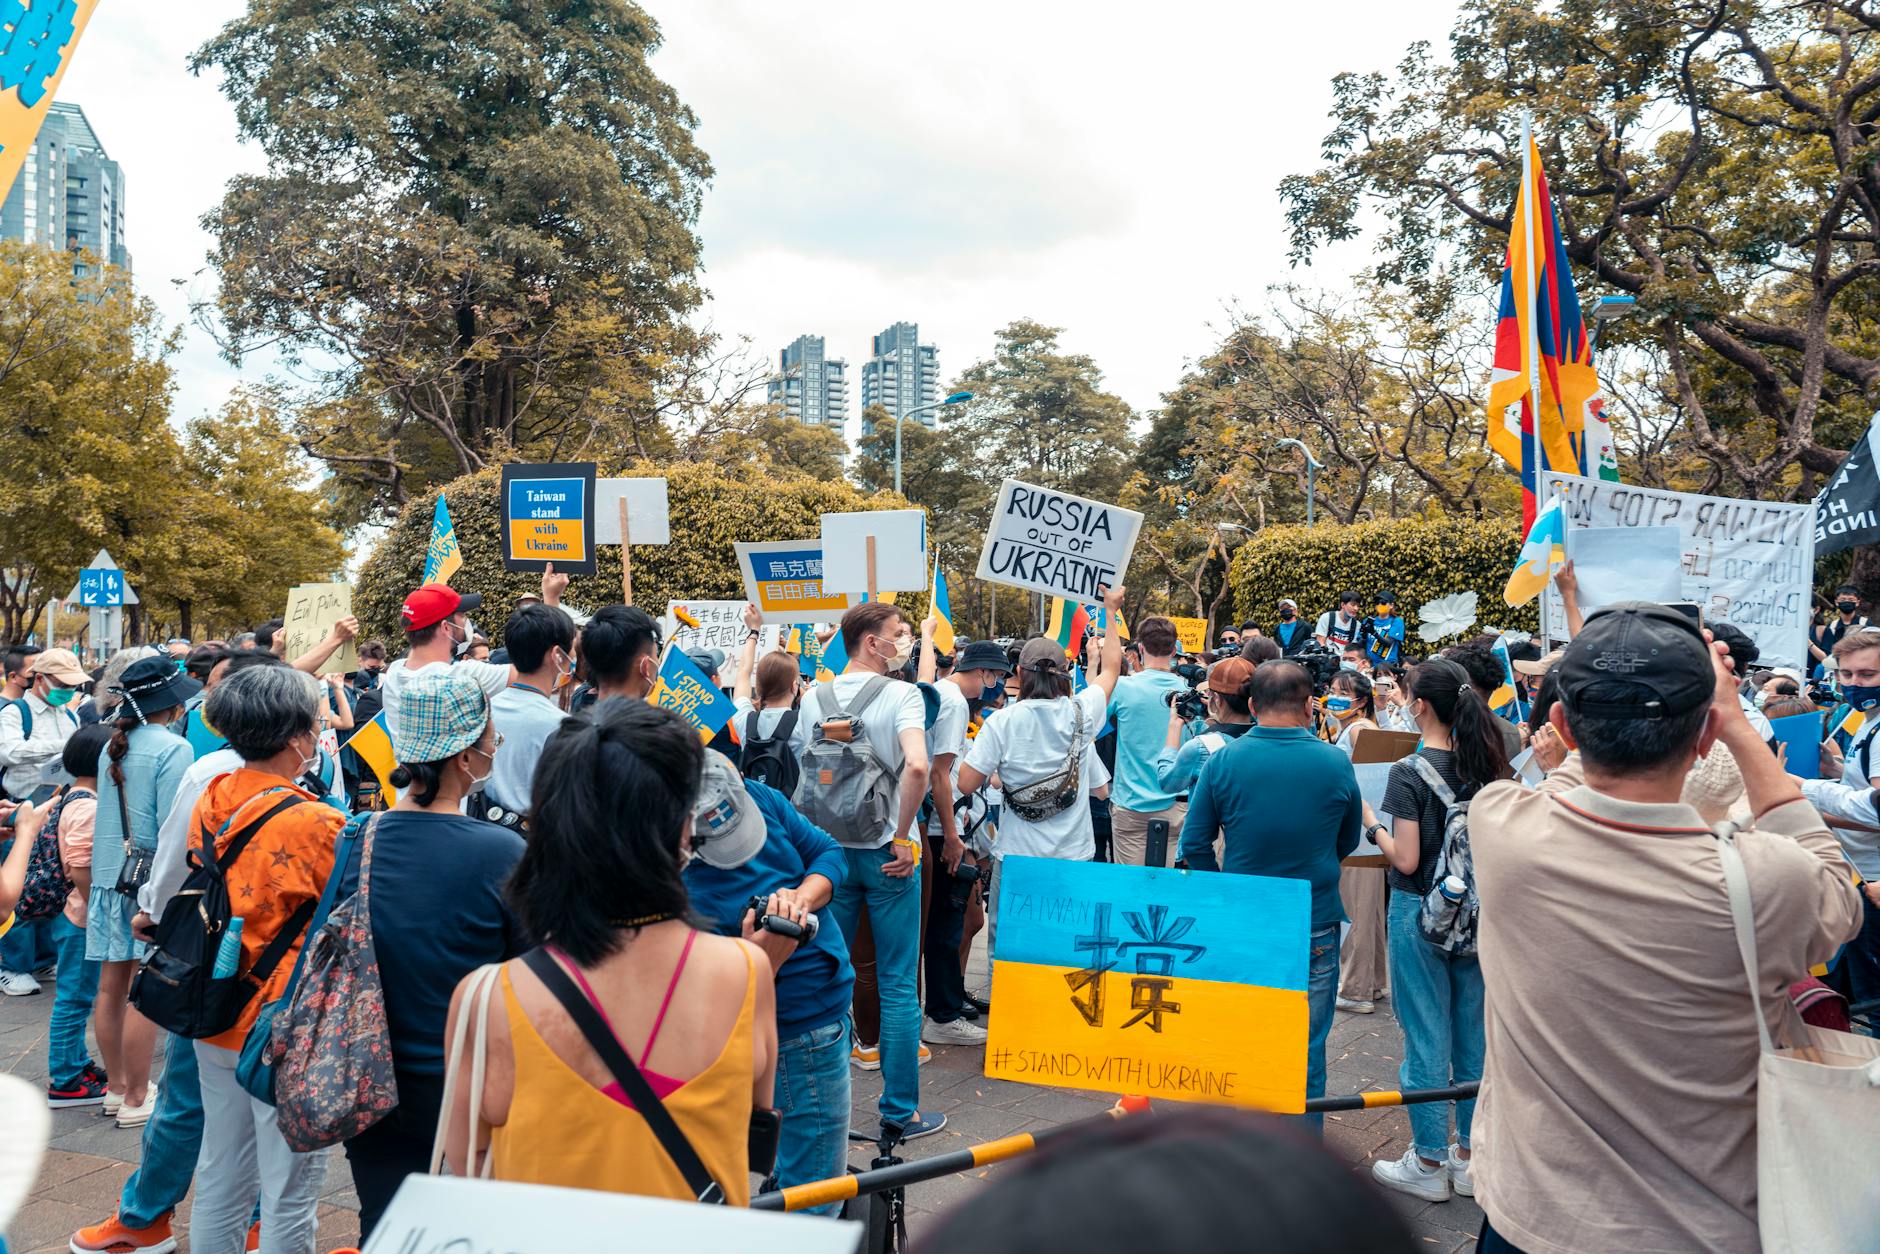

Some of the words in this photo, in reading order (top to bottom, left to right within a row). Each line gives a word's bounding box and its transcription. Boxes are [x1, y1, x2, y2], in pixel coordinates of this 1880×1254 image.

[526, 489, 566, 502] Taiwan
[531, 506, 560, 518] stand
[1007, 487, 1112, 540] RUSSIA
[534, 523, 558, 534] with
[1027, 528, 1063, 545] OUT
[1068, 537, 1093, 553] OF
[526, 539, 568, 551] Ukraine
[989, 541, 1116, 601] UKRAINE
[1593, 658, 1648, 670] GOLF
[673, 685, 700, 712] WITH
[679, 675, 715, 705] STAND
[1007, 891, 1091, 925] TAIWAN
